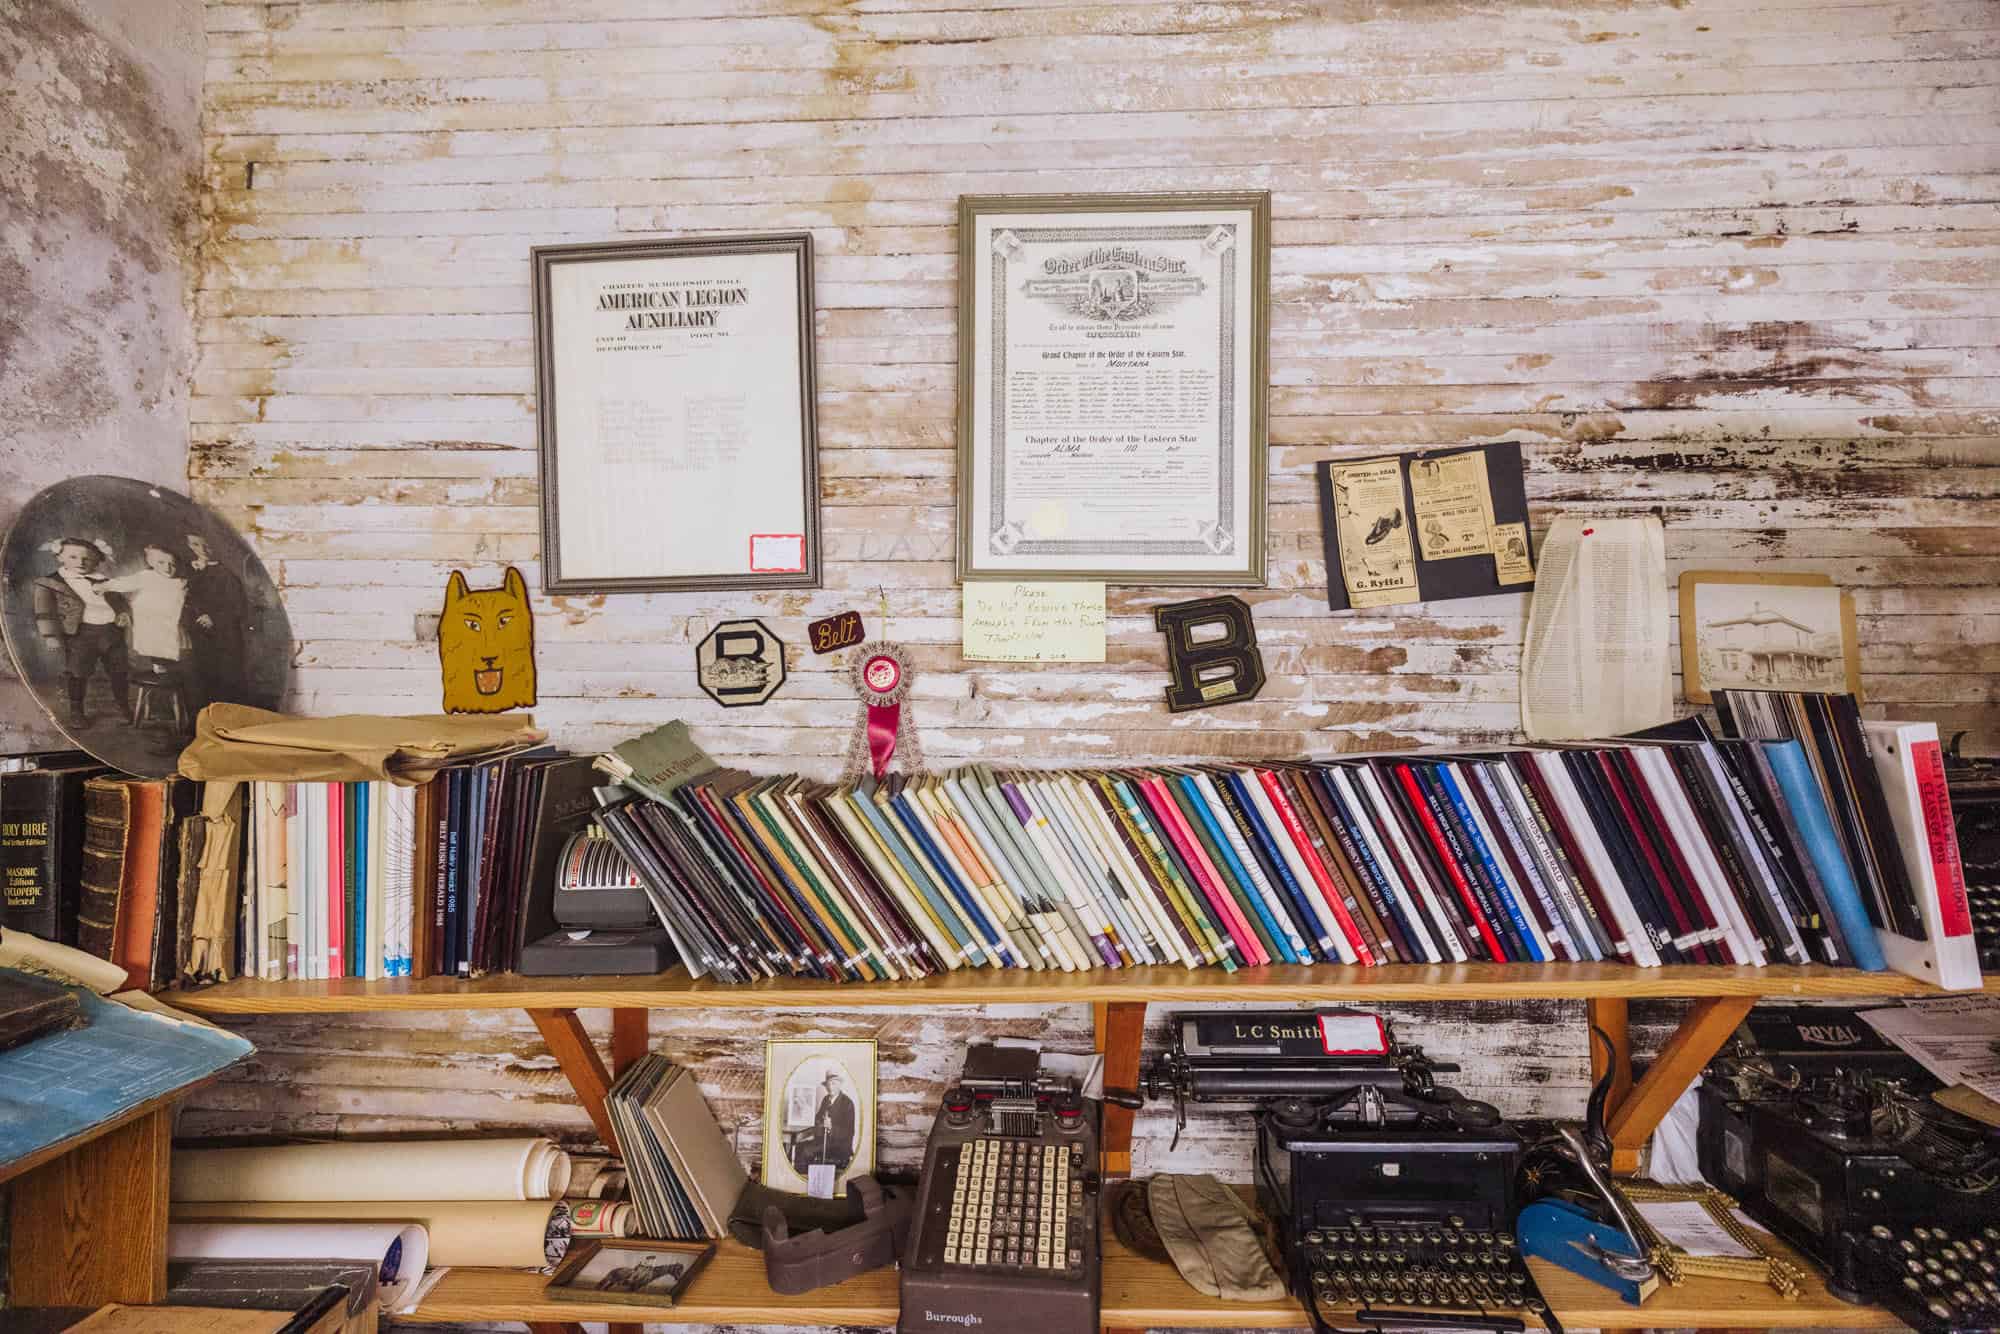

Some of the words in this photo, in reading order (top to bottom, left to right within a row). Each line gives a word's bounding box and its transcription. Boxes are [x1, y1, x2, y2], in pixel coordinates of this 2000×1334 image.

[595, 290, 680, 311] AMERICAN
[684, 287, 748, 306] LEGION
[624, 310, 720, 330] AUXILIARY
[1025, 434, 1058, 444] Chapter
[1061, 435, 1070, 443] of
[1073, 434, 1086, 443] the
[1089, 434, 1113, 443] Order
[1115, 434, 1125, 443] of
[1127, 434, 1142, 443] the
[1144, 434, 1177, 443] Eastern
[1356, 581, 1368, 589] G.
[815, 616, 857, 651] Belt
[1153, 595, 1266, 713] B
[1920, 782, 1937, 820] CLASS
[2, 822, 20, 837] HOLY
[22, 822, 48, 837] BIBLE
[438, 820, 448, 841] BELT
[1231, 807, 1254, 838] Herald
[437, 841, 447, 871] HUSKY
[1330, 814, 1346, 835] BELT
[1341, 835, 1362, 864] HUSKY
[1356, 863, 1380, 898] HERALD
[1524, 816, 1544, 846] HUSKY
[1541, 848, 1564, 883] HERALD
[7, 866, 39, 877] MASONIC
[1425, 794, 1441, 814] BELT
[1444, 829, 1464, 859] SCHOOL
[1473, 885, 1494, 914] HERALD
[1490, 916, 1505, 935] 1991
[436, 872, 446, 906] HERALD
[1234, 1026, 1247, 1038] L
[1251, 1025, 1264, 1038] C
[1270, 1025, 1321, 1039] Smith
[1797, 1023, 1862, 1045] ROYAL
[925, 1310, 983, 1327] Burroughs
